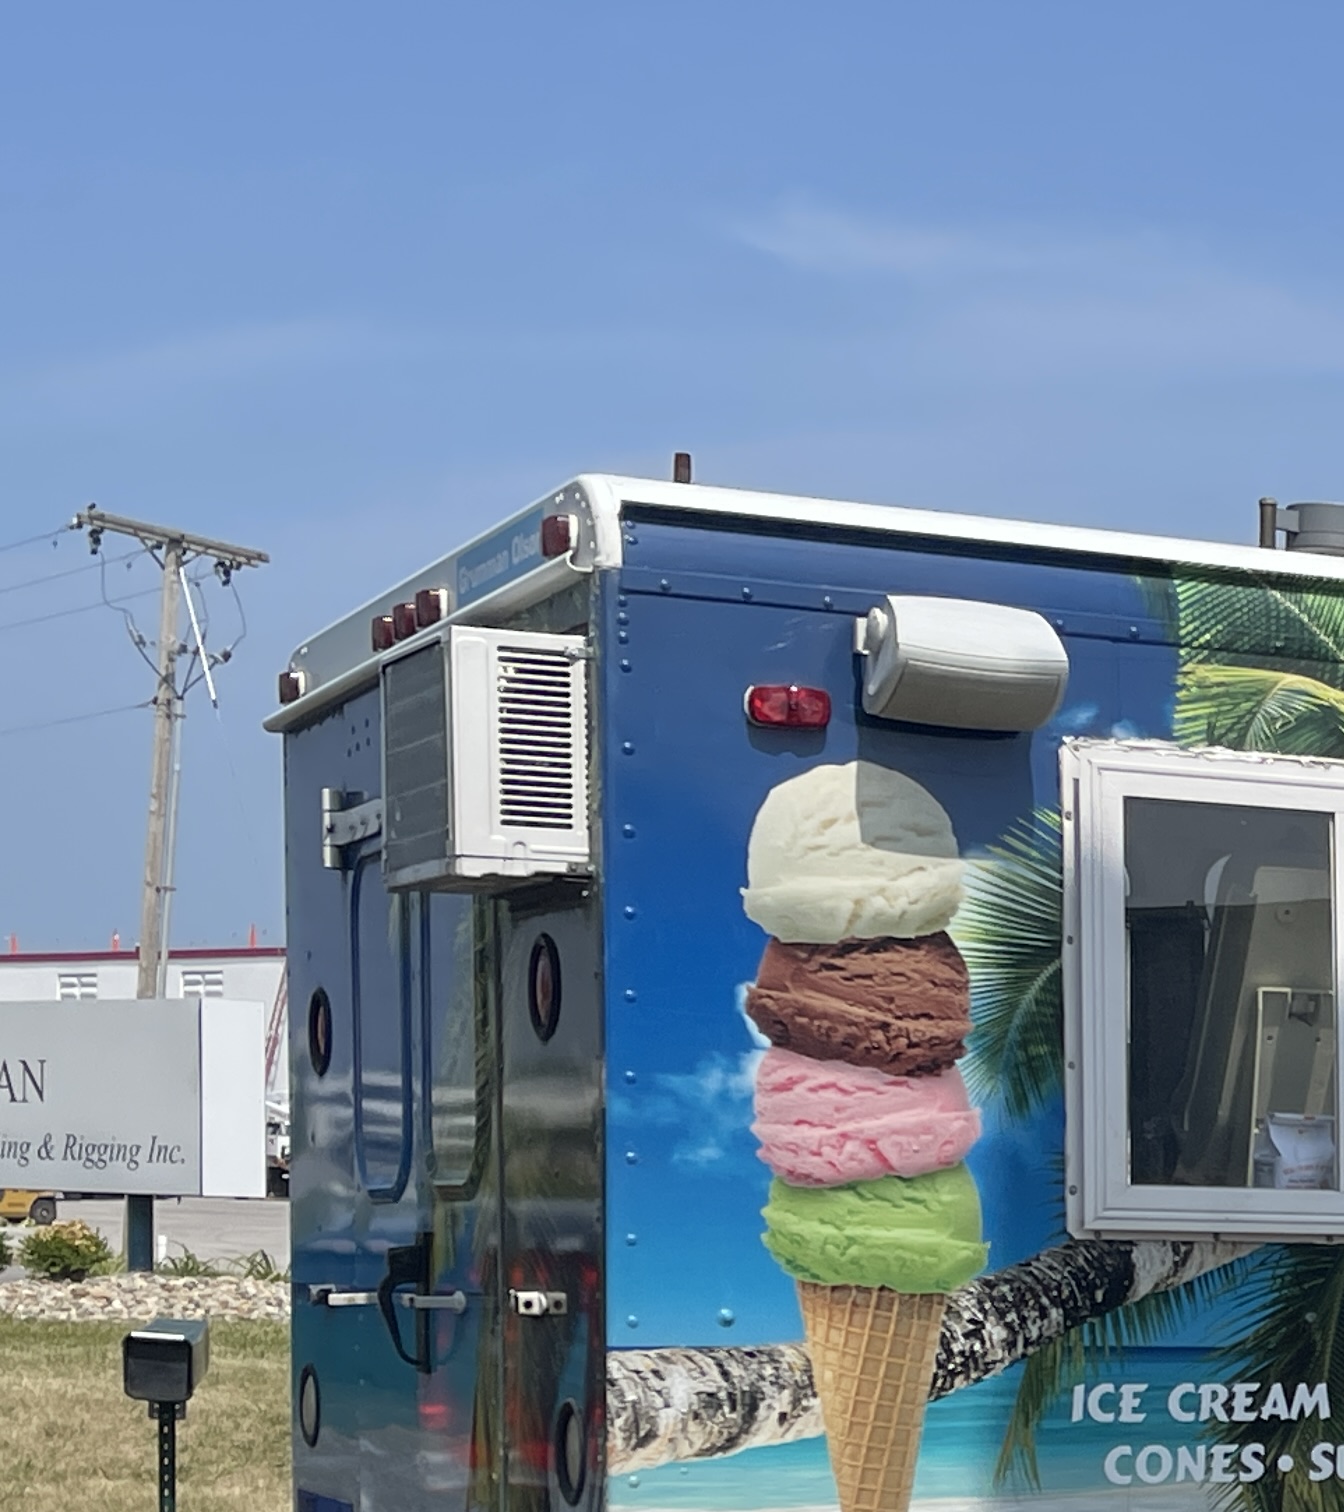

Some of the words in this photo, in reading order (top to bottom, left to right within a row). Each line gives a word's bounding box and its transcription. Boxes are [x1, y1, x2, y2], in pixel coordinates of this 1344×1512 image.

[38, 1132, 55, 1161] &
[61, 1133, 142, 1171] Rigging
[146, 1135, 186, 1165] Inc.
[1071, 1383, 1149, 1424] ICE
[1168, 1382, 1332, 1423] CREAM
[1103, 1442, 1266, 1485] CONES
